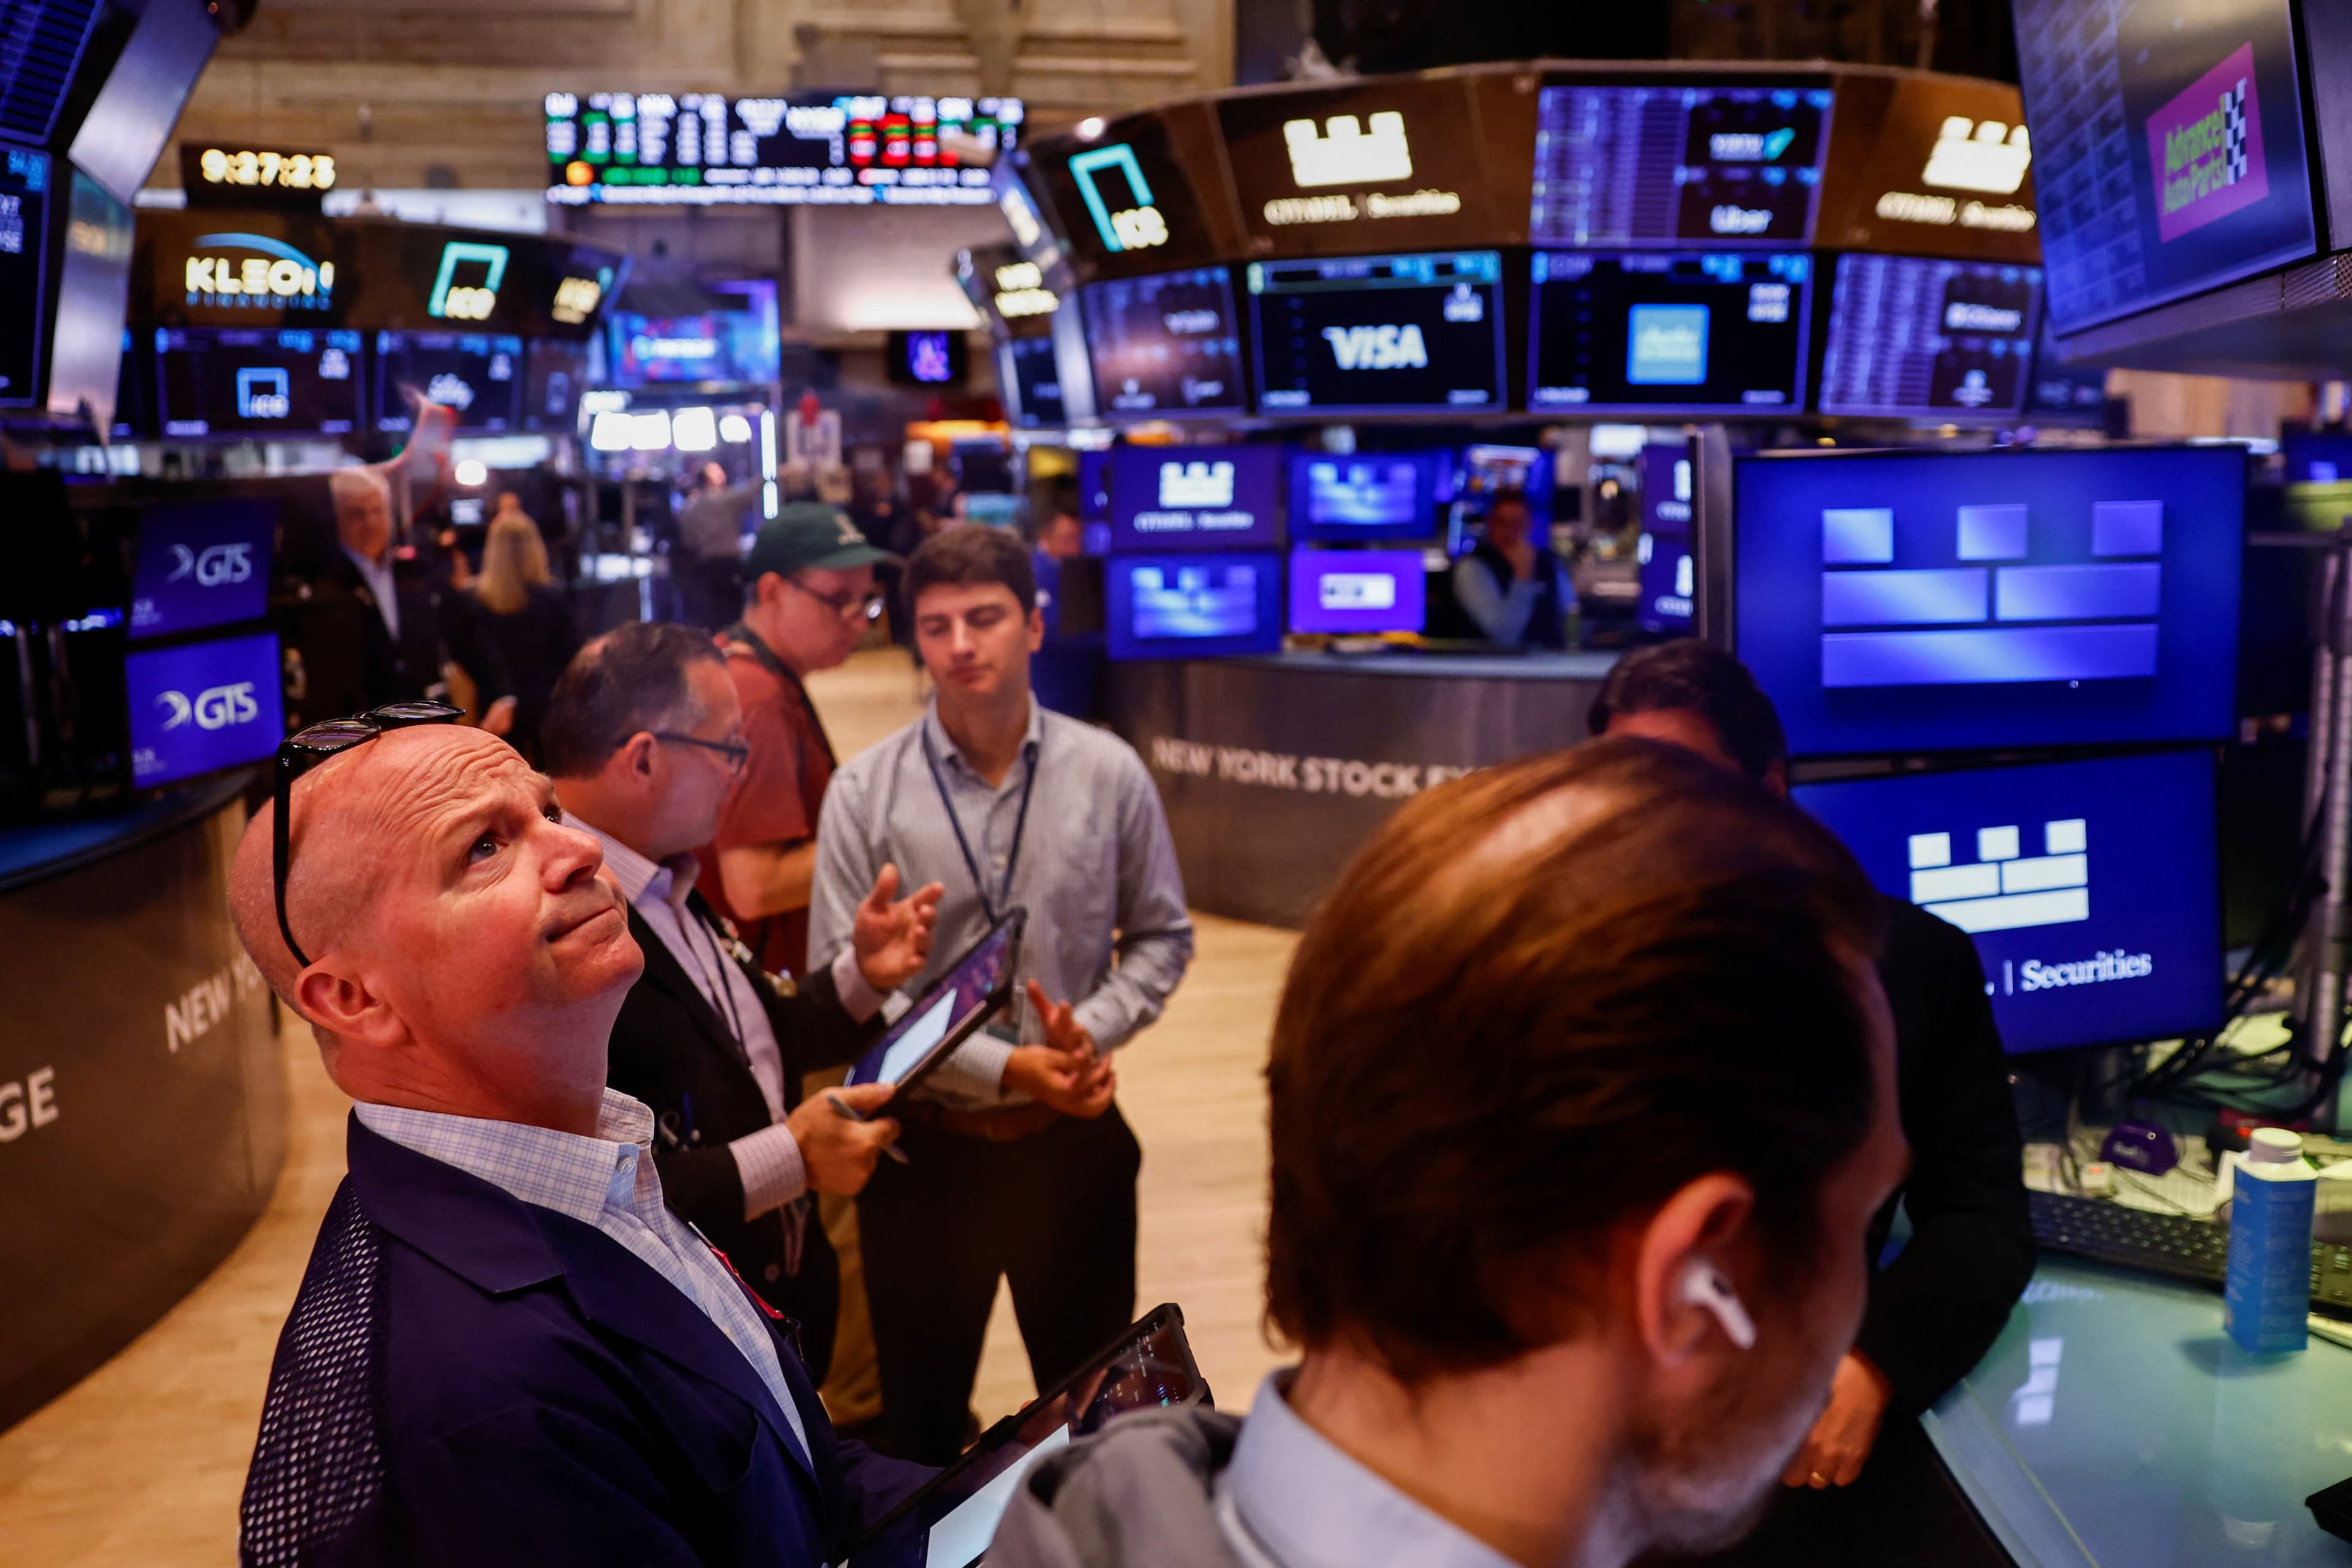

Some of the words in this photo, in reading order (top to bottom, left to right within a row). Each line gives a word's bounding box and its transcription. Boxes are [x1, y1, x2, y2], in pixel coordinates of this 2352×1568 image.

[1321, 323, 1428, 370] VISA
[194, 680, 258, 731] GTS
[1151, 736, 1215, 777] NEW
[1215, 743, 1298, 791] YORK
[1299, 755, 1421, 797] STOCK
[2021, 948, 2153, 993] Securities
[165, 965, 231, 1054] NEW
